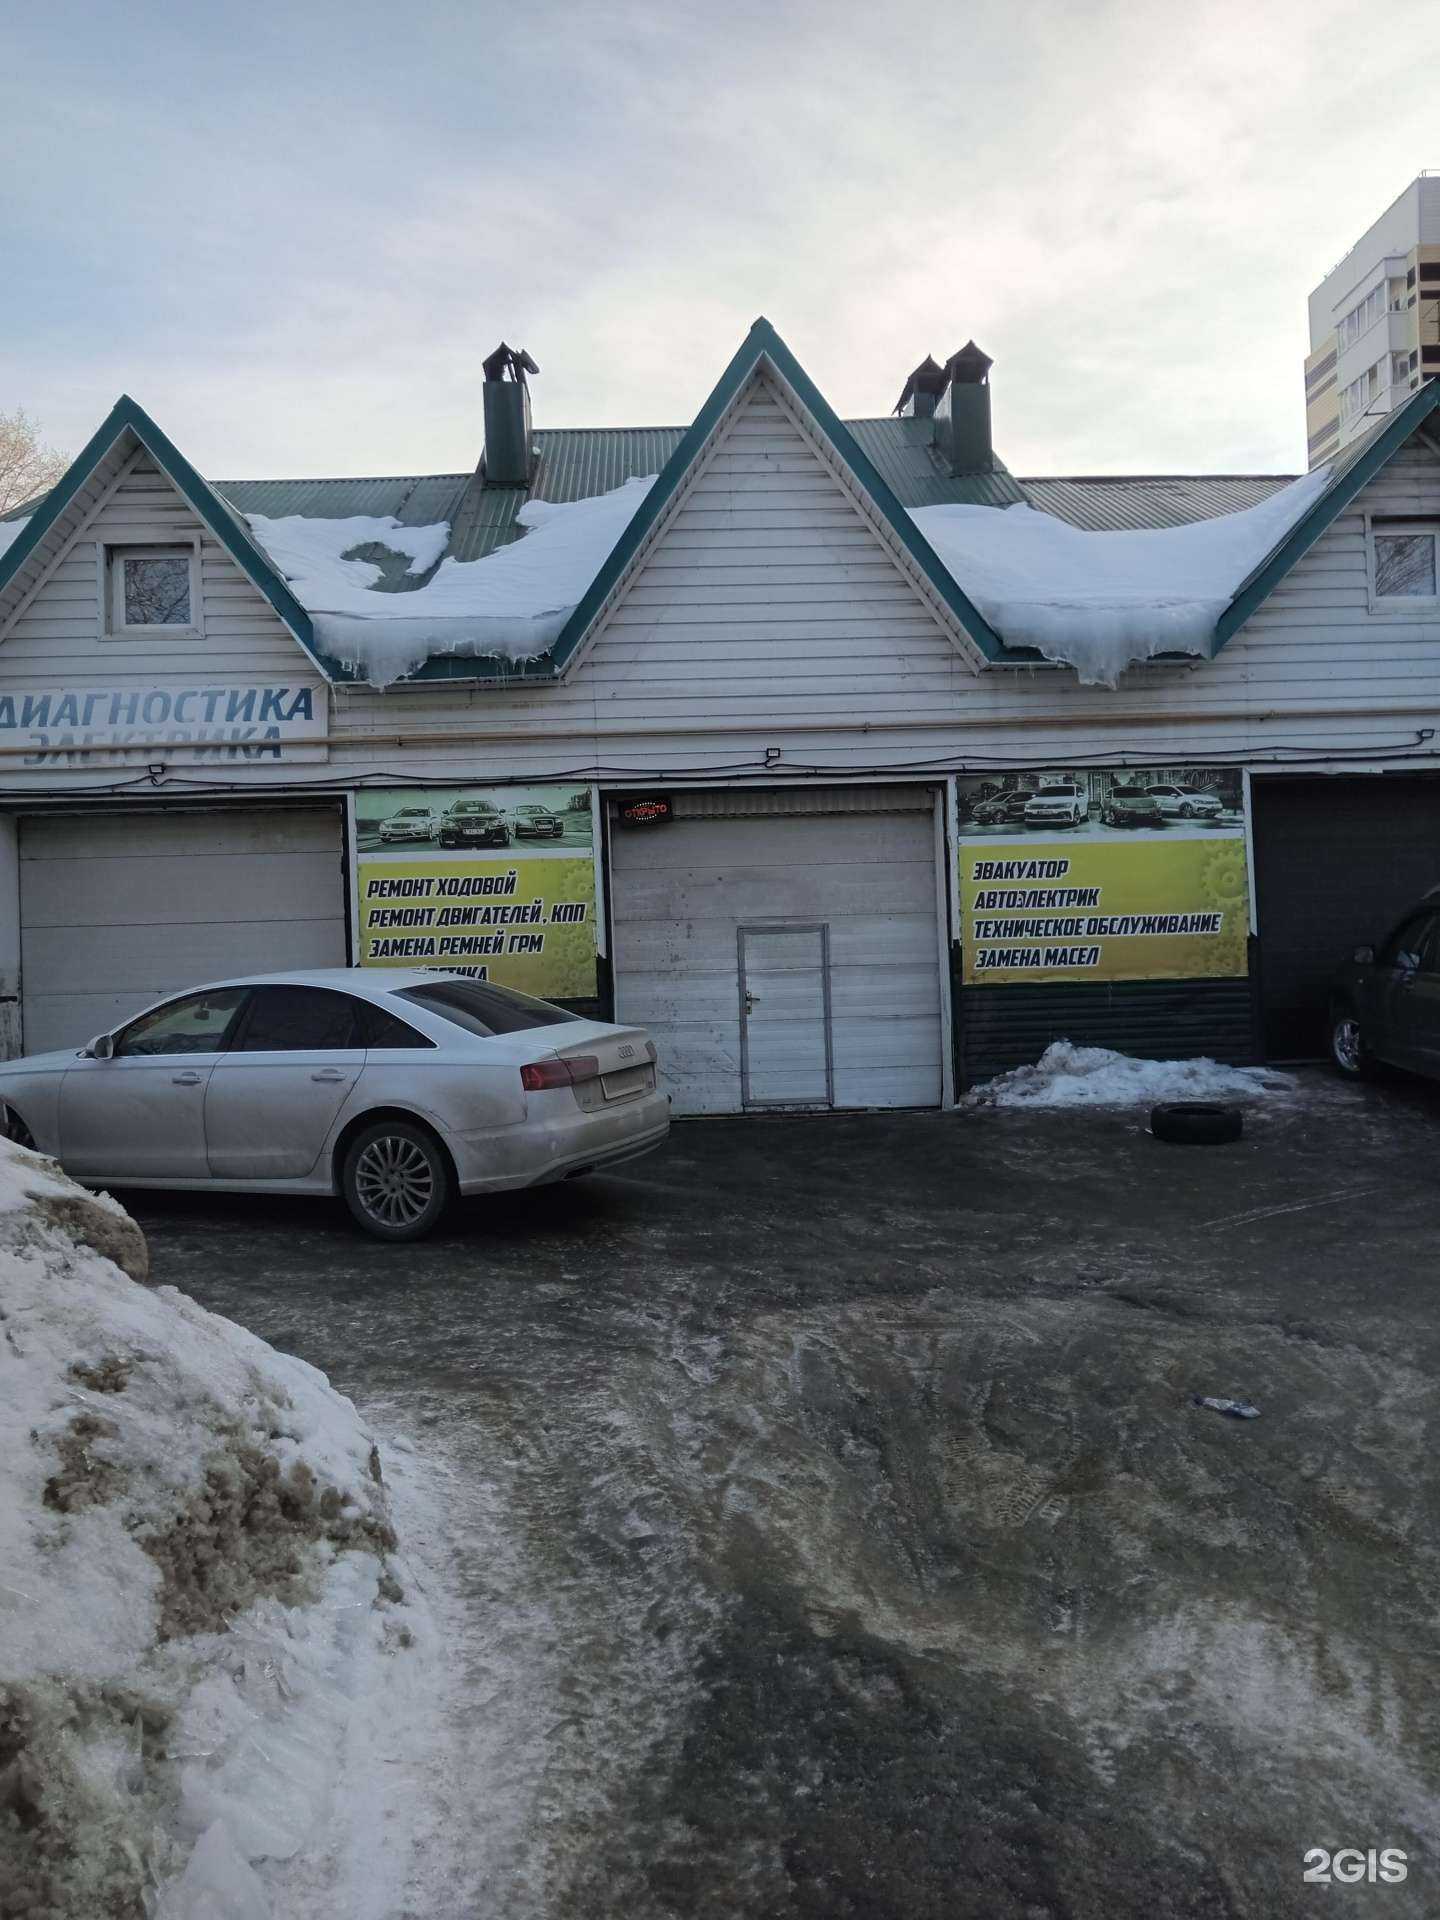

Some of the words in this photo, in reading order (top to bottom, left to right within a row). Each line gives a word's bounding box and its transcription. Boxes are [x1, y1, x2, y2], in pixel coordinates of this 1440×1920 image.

[0, 688, 314, 728] ДИАГНОСТИКА
[624, 804, 667, 817] ОТКРЫТО
[973, 860, 1069, 881] ЭВАКУАТОР
[367, 878, 435, 898] РЕМОНТ
[436, 870, 517, 896] ХОДОВОЙ
[974, 888, 1101, 910] АВТОЭЛЕКТРИК
[368, 907, 436, 928] РЕМОНТ
[551, 903, 586, 923] КПП
[974, 918, 1085, 939] ТЕХНИЧЕСКОЕ
[1086, 913, 1222, 936] ОБСЛУЖИВАНИЕ
[369, 937, 435, 958] ЗАМЕНА
[438, 929, 506, 955] РЕМНЕЙ
[508, 934, 544, 953] ГРМ
[975, 949, 1041, 968] ЗАМЕНА
[1044, 947, 1100, 966] МАСЕЛ
